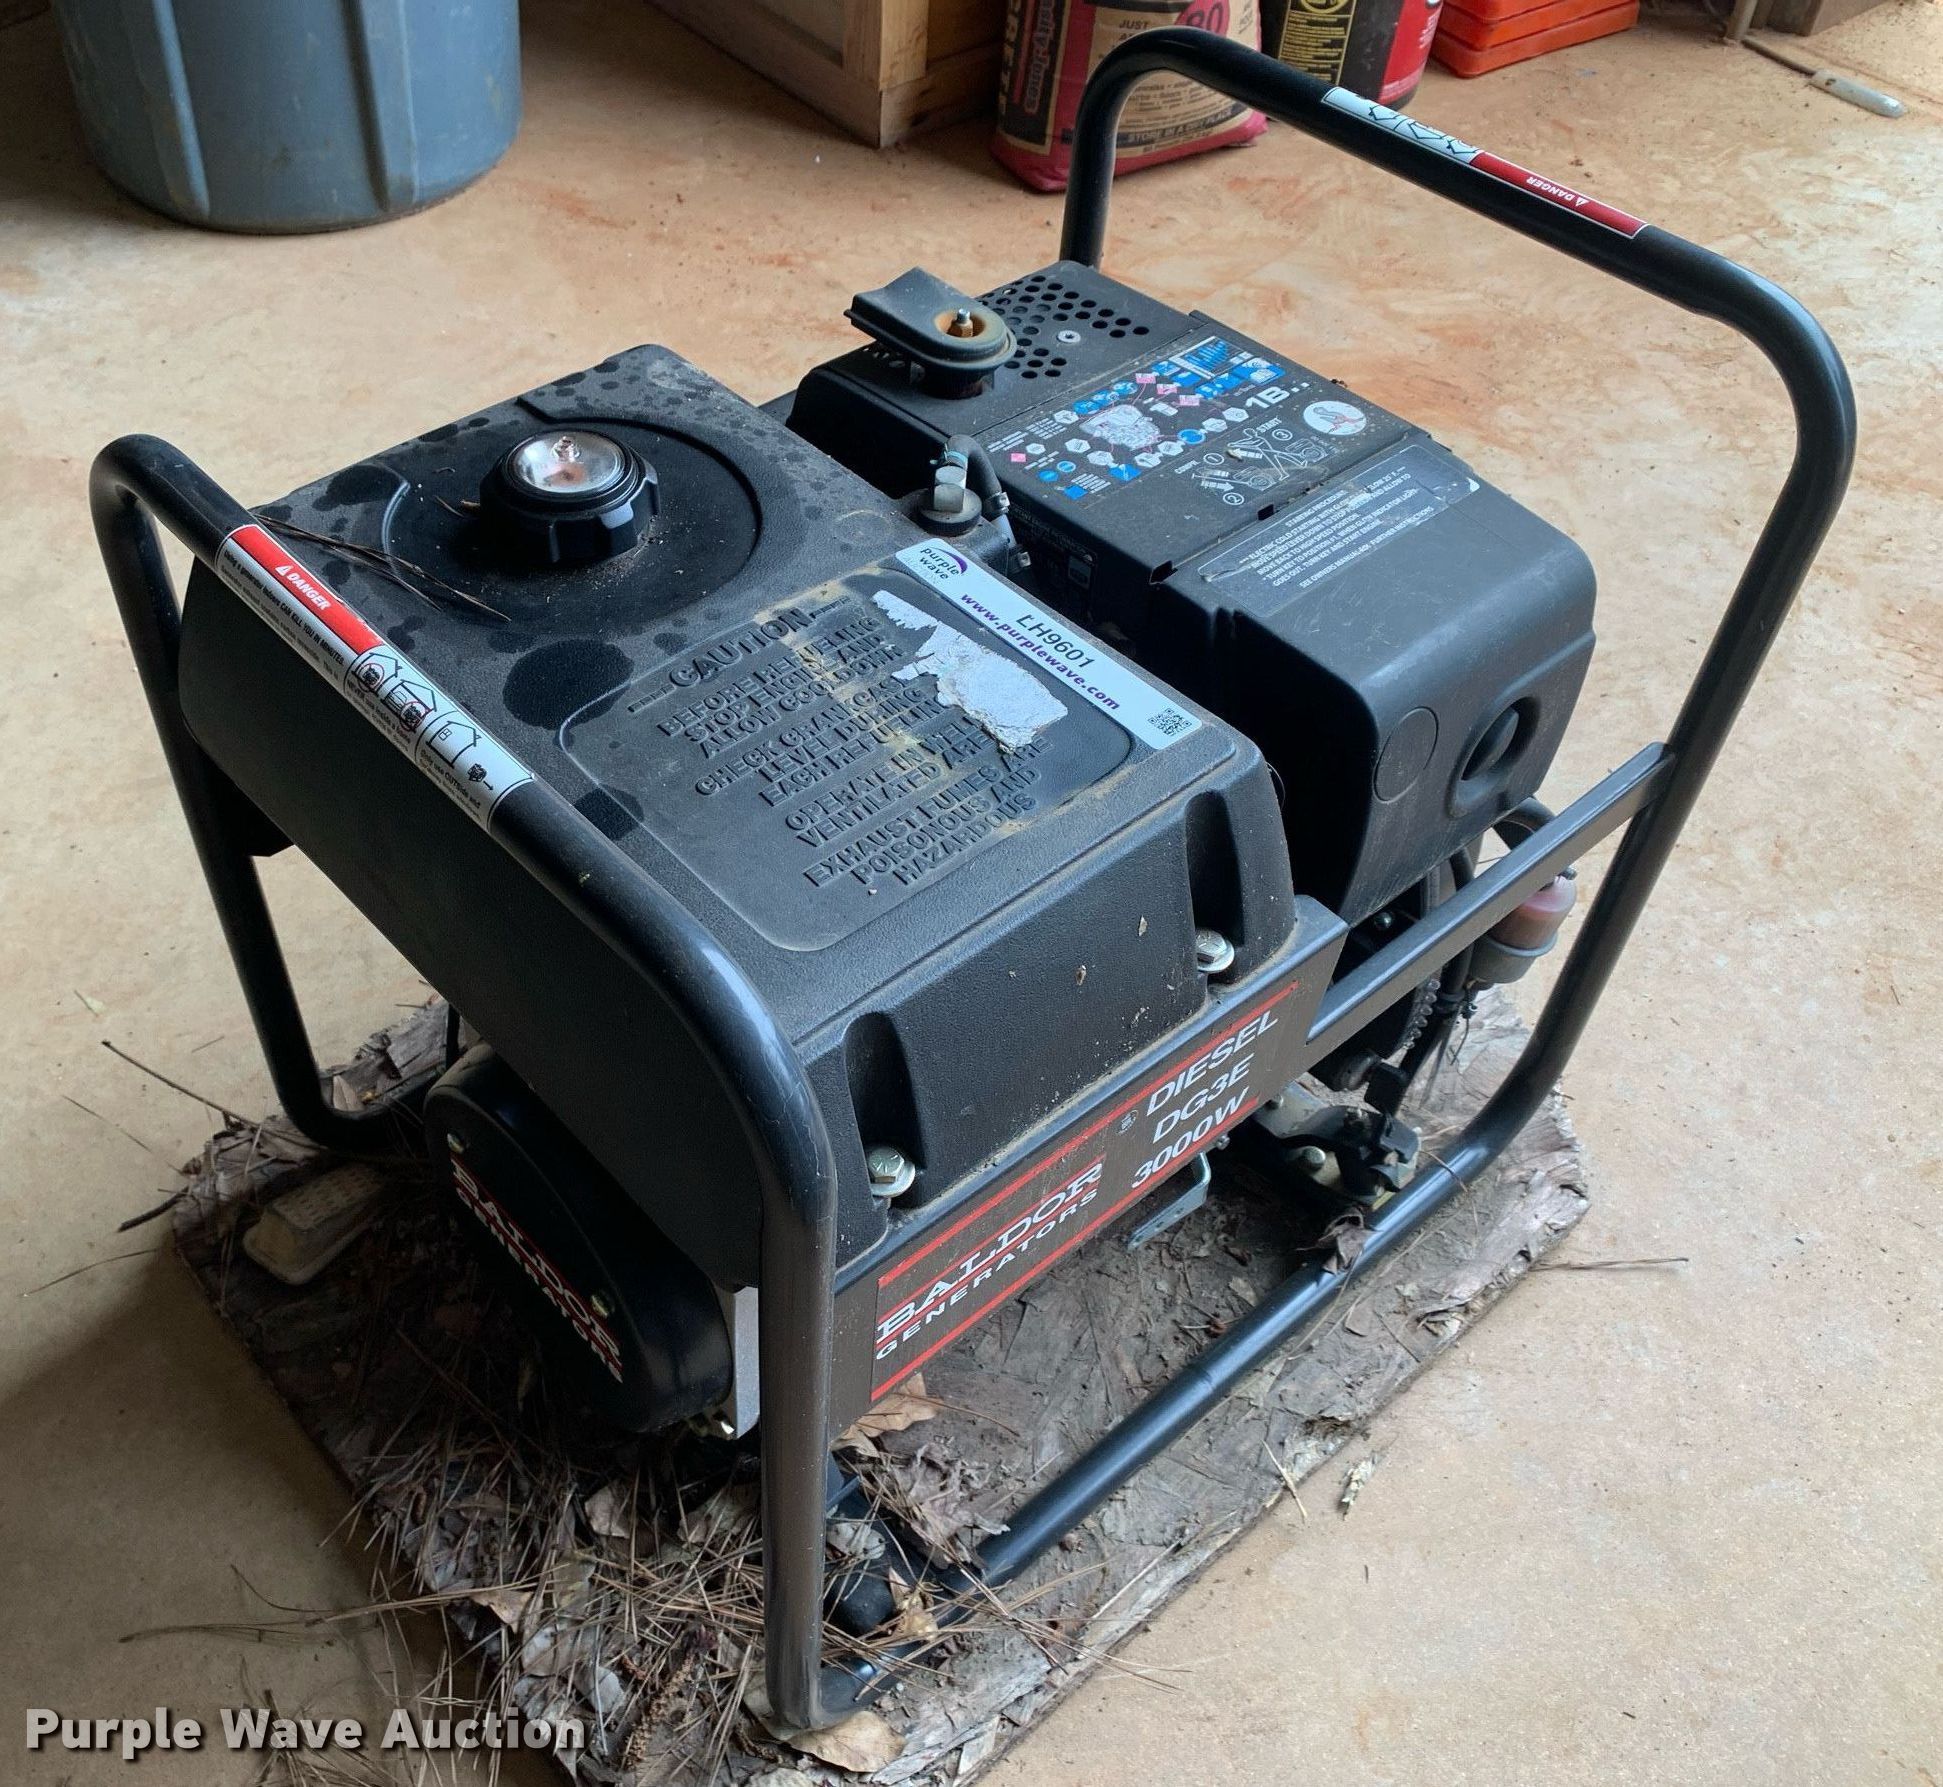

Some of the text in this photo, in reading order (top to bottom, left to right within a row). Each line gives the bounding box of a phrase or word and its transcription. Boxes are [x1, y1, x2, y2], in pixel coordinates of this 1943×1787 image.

[1119, 19, 1149, 30] JUST
[1526, 176, 1576, 201] DANGER
[1255, 418, 1283, 435] START
[1247, 541, 1278, 559] ELECTRIC
[1273, 531, 1294, 544] COLD
[1289, 516, 1321, 535] STARTING
[1316, 507, 1335, 519] WITH
[1250, 554, 1272, 568] MOVE
[1267, 543, 1290, 557] SPEED
[1285, 533, 1307, 547] LEVER
[1303, 523, 1325, 537] DOWN
[1321, 518, 1334, 526] TO
[1381, 477, 1404, 491] ALLOW
[1400, 472, 1412, 480] TO
[1255, 561, 1278, 575] MOVE
[1273, 551, 1294, 564] BACK
[1289, 546, 1302, 554] TO
[1298, 537, 1317, 549] HIGH
[1312, 527, 1334, 541] SPEED
[1264, 566, 1285, 580] TURN
[1281, 559, 1297, 570] KEY
[1293, 554, 1305, 563] TO
[1301, 538, 1332, 558] POSITION
[1336, 524, 1358, 537] WHEN
[1353, 514, 1374, 527] GLOW
[1270, 573, 1292, 586] GOES
[1301, 555, 1322, 568] TURN
[1317, 548, 1332, 558] KEY
[1328, 540, 1346, 552] AND
[1341, 530, 1363, 544] START
[1284, 509, 1315, 527] STARTING
[1298, 578, 1313, 588] SEE
[1309, 563, 1338, 581] OWNERS
[1368, 527, 1397, 545] FURTHER
[1392, 505, 1434, 531] INSTRUCTIONS
[287, 571, 332, 611] DANGER
[916, 556, 951, 580] wave
[919, 547, 963, 576] purple
[278, 601, 293, 615] CAN
[289, 611, 305, 626] KILL
[301, 623, 315, 637] YOU
[311, 632, 322, 643] IN
[663, 605, 815, 691] CAUTION
[957, 593, 1121, 712] www.purplewave.com
[1015, 613, 1096, 669] LH9601
[655, 612, 883, 737] BEFORE REFUELING
[680, 628, 890, 744] STOP ENGINE AND
[688, 739, 785, 798] CHECK
[694, 703, 787, 758] ALLOW
[755, 684, 930, 783] LEVEL DURING
[757, 758, 835, 807] EACH
[780, 761, 900, 834] OPERATE
[889, 745, 928, 772] IN
[795, 759, 946, 850] VENTILATED
[801, 732, 1058, 888] EXHAUST FUMES ARE
[848, 763, 1046, 885] POISONOUS AND
[889, 790, 1043, 886] HAZARDOUS
[1147, 1011, 1278, 1117] DIESEL
[1152, 1053, 1254, 1145] DG3E
[1131, 1086, 1250, 1189] 3000W
[451, 1159, 623, 1367] BALDOR
[456, 1186, 623, 1384] GENERATORS
[876, 1189, 1099, 1360] GENERATORS
[877, 1162, 1101, 1344] BALDOR
